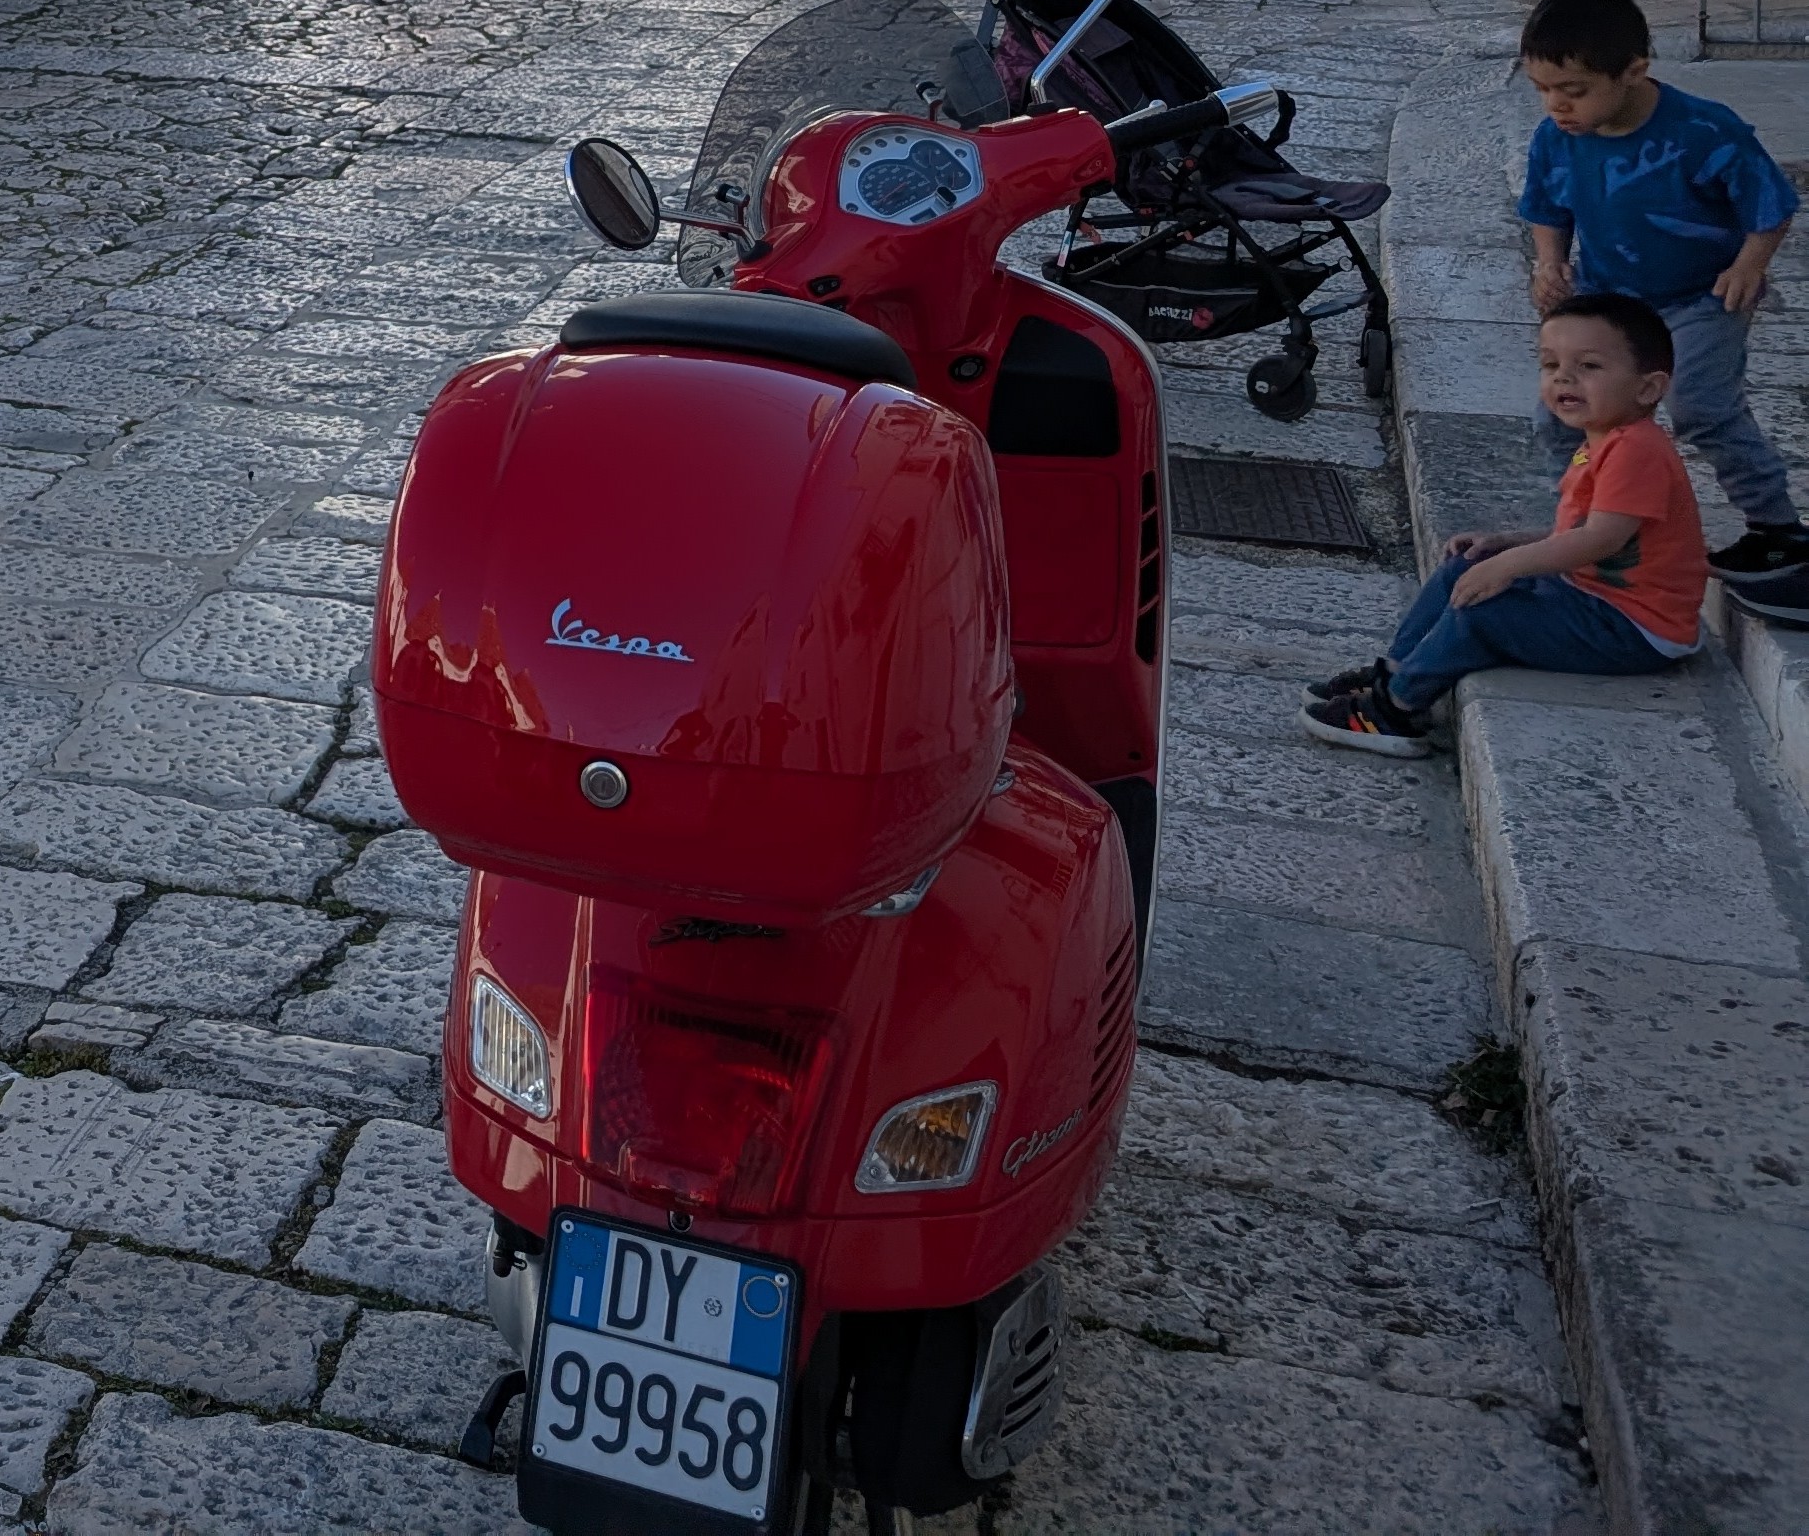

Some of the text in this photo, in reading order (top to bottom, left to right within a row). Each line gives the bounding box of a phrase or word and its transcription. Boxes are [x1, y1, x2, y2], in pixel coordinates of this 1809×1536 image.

[545, 598, 694, 662] Vespa
[606, 1237, 698, 1342] DY
[549, 1351, 767, 1492] 99958
